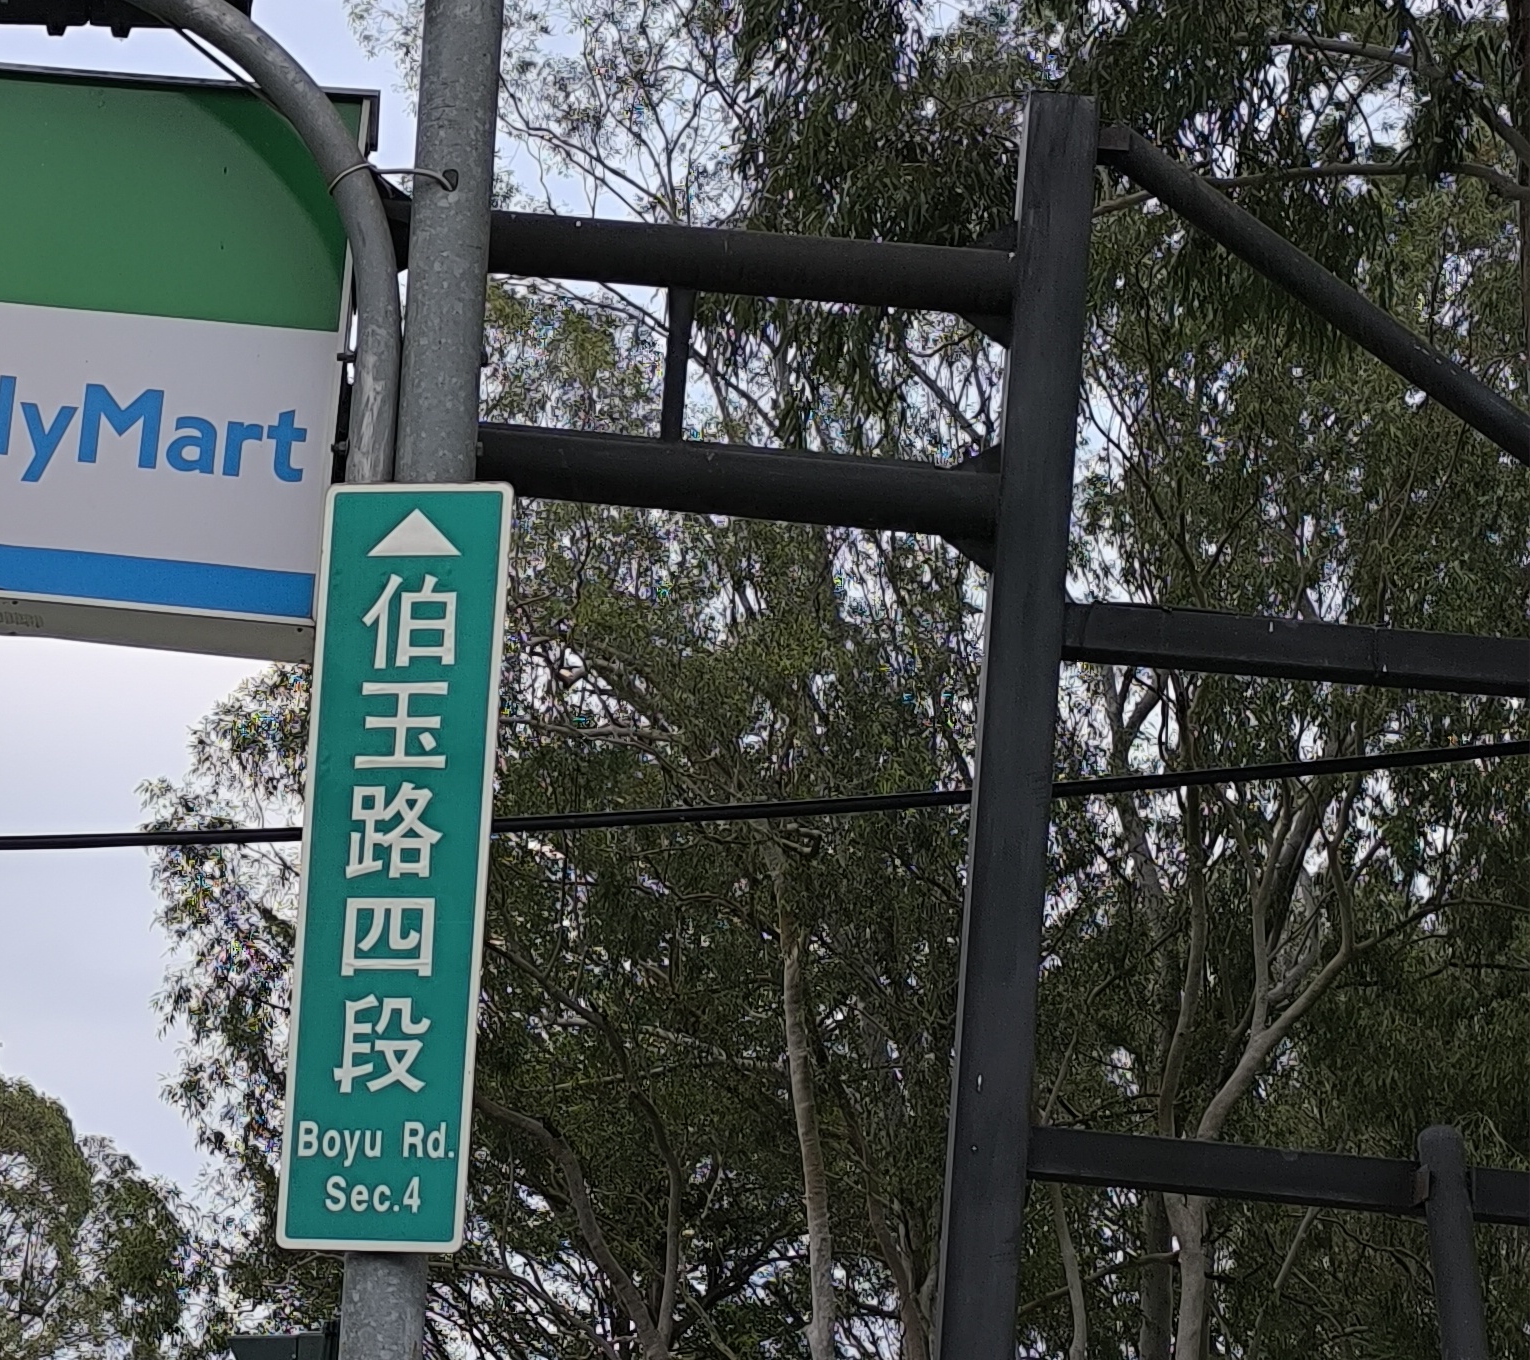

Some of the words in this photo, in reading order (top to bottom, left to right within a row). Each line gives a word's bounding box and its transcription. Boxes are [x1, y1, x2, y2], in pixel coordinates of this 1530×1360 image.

[332, 573, 458, 1094] 伯玉路四段
[296, 1120, 383, 1168] Boyu
[402, 1121, 456, 1160] Rd.
[324, 1175, 421, 1213] Sec.4
